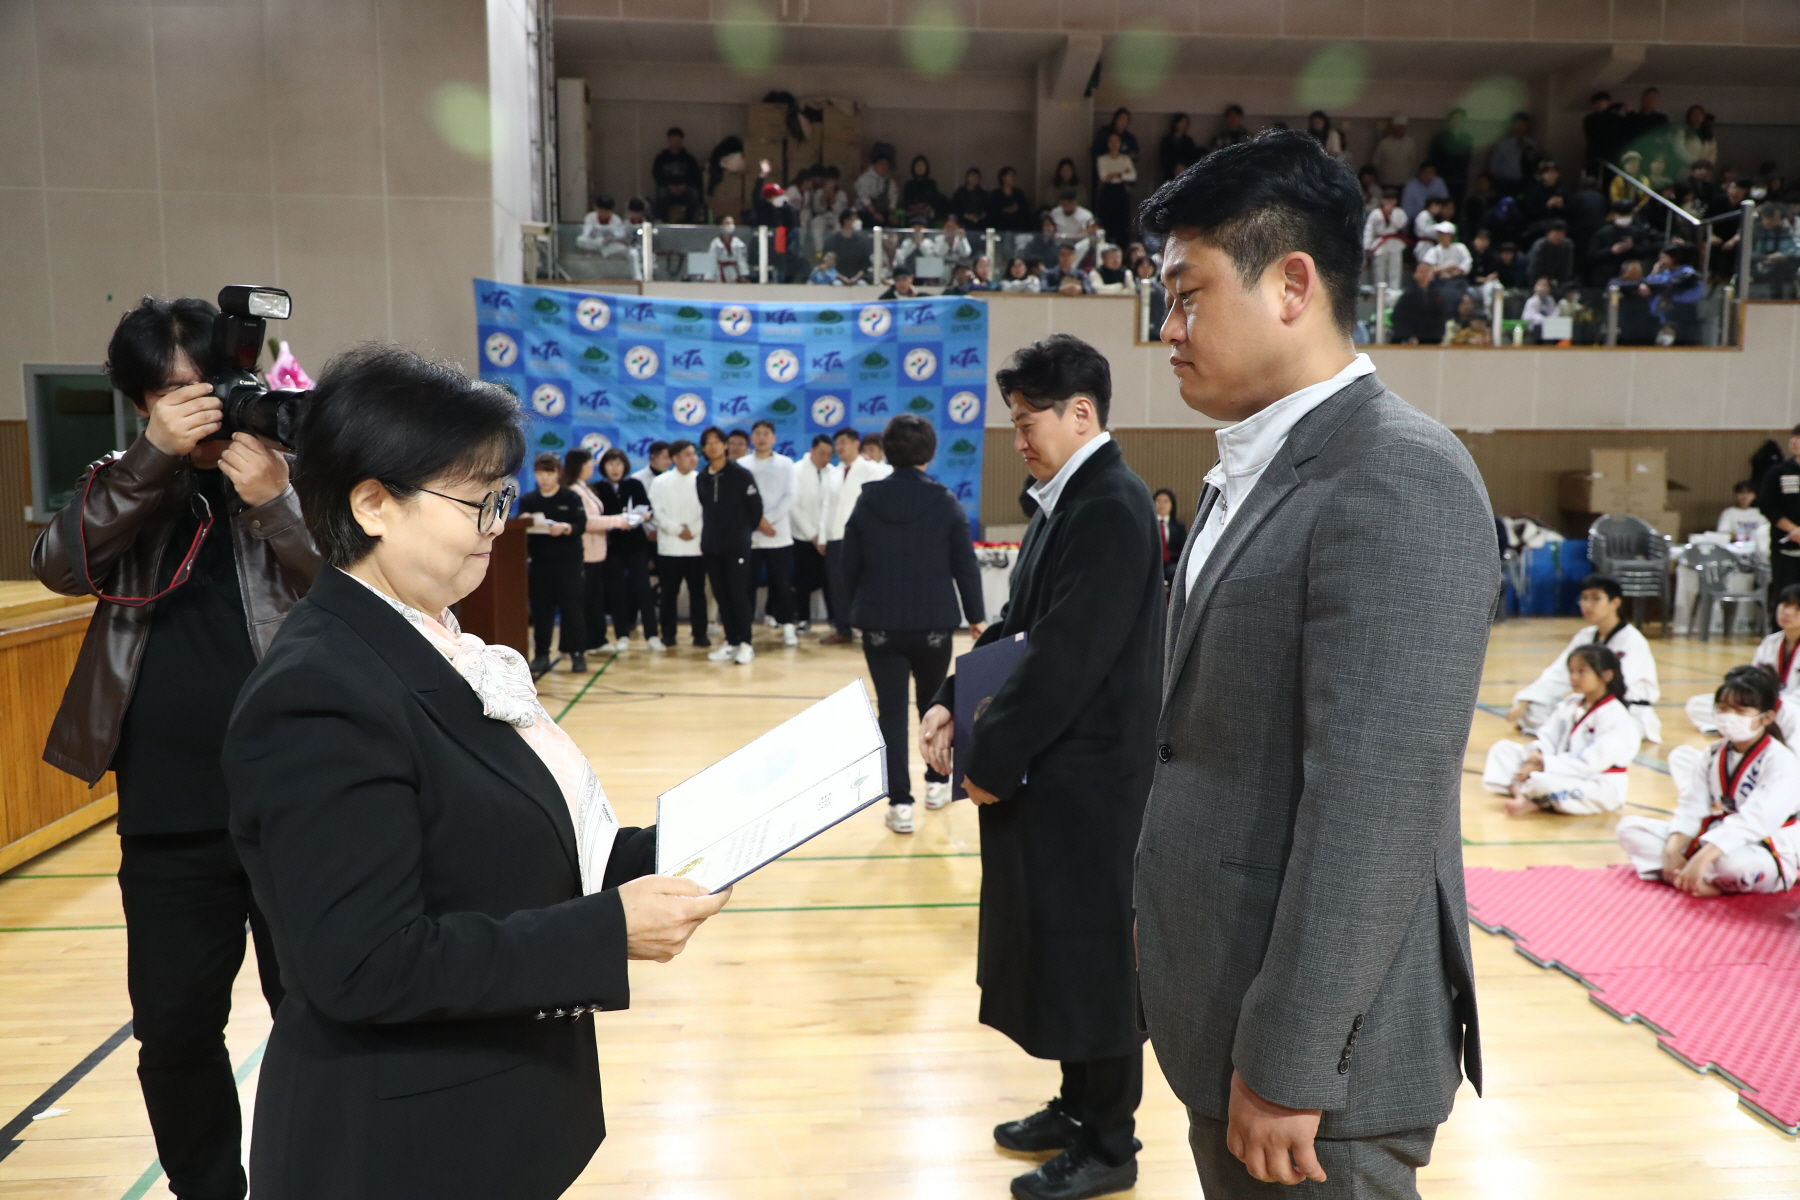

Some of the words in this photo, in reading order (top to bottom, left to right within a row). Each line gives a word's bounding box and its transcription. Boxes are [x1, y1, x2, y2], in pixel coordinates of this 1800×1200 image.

[482, 290, 513, 309] KTA
[625, 302, 656, 321] KTA
[766, 308, 797, 324] KTA
[904, 304, 936, 324] KTA
[531, 341, 563, 360] KTA
[673, 349, 705, 369] KTA
[950, 348, 981, 368] KTA
[812, 351, 844, 372] KTA
[579, 390, 611, 410] KTA
[720, 395, 751, 416] KTA
[858, 395, 888, 415] KTA
[626, 437, 654, 457] KT
